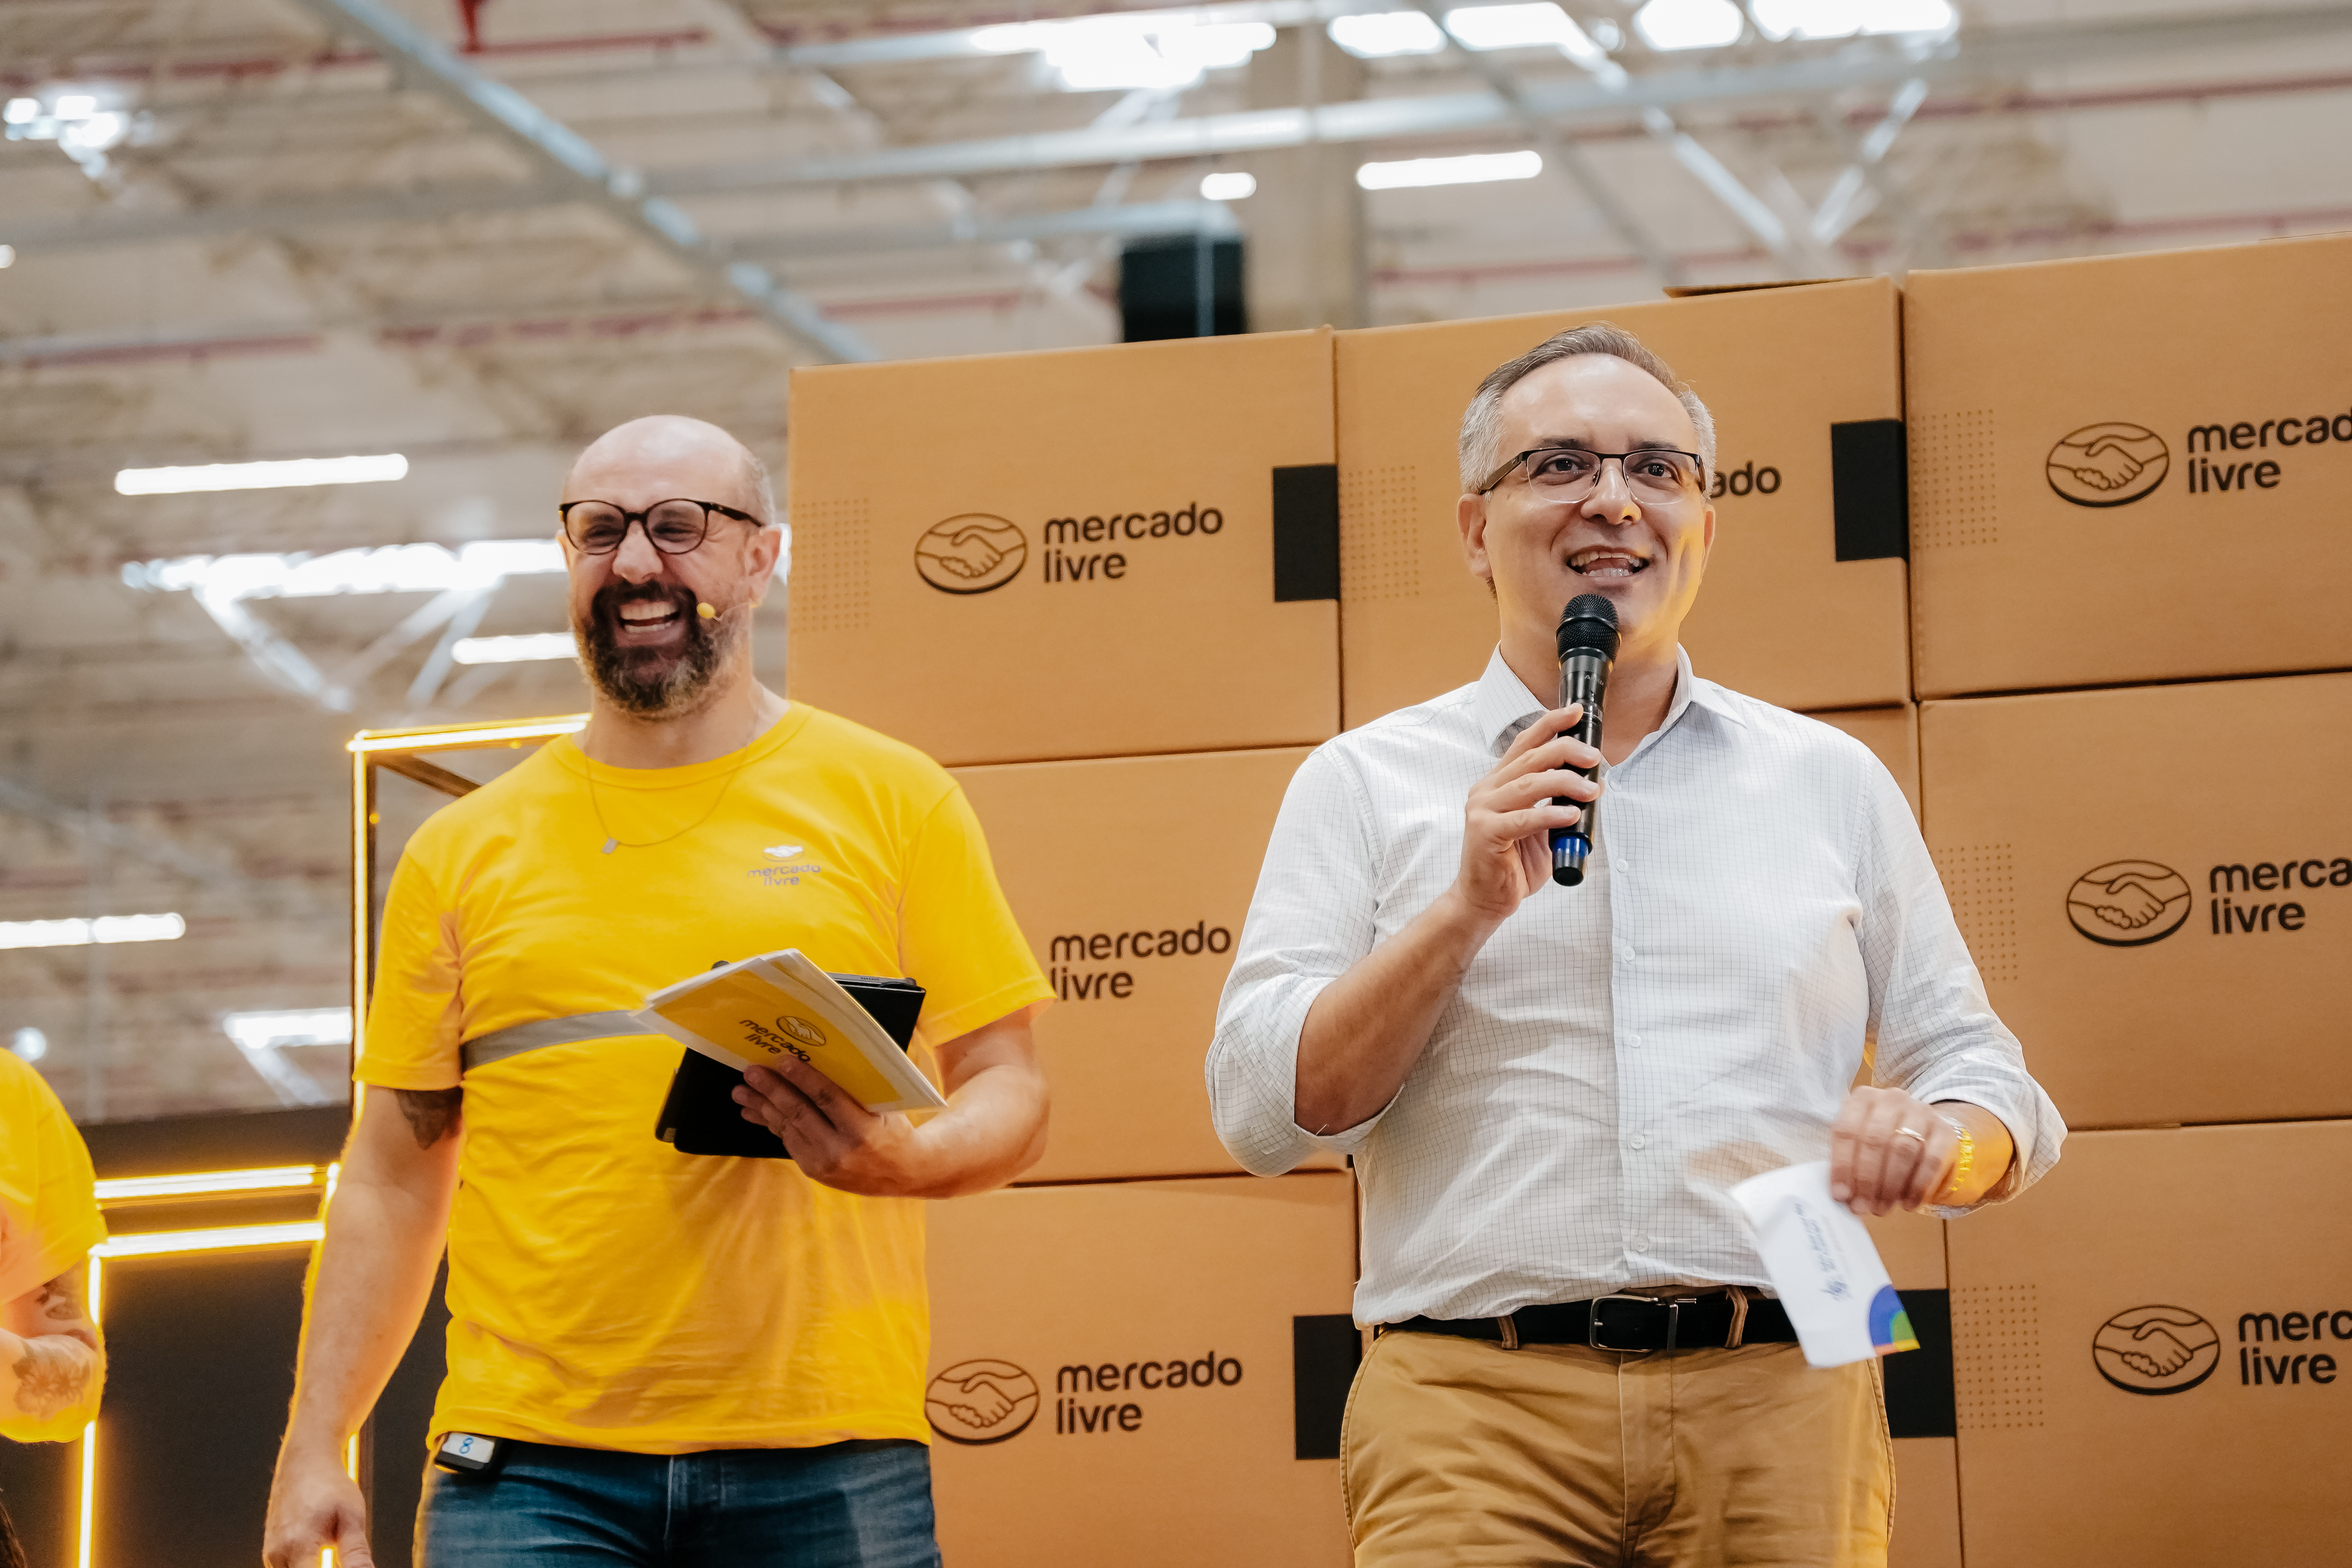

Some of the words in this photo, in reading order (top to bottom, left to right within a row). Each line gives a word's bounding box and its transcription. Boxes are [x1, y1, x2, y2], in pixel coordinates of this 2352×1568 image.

[2188, 457, 2281, 494] livre
[1043, 500, 1223, 545] mercado
[1043, 548, 1127, 583] livre
[747, 864, 821, 878] mercado
[764, 876, 800, 886] livre
[2210, 857, 2352, 894] merca
[2211, 896, 2306, 936] livre
[1050, 919, 1232, 962] mercado
[1050, 966, 1134, 1002] livre
[739, 1019, 811, 1062] mercado
[744, 1033, 781, 1054] livre
[1056, 1350, 1243, 1393] mercado
[2240, 1346, 2337, 1386] livre
[1056, 1397, 1143, 1435] livre
[459, 1436, 474, 1454] 8
